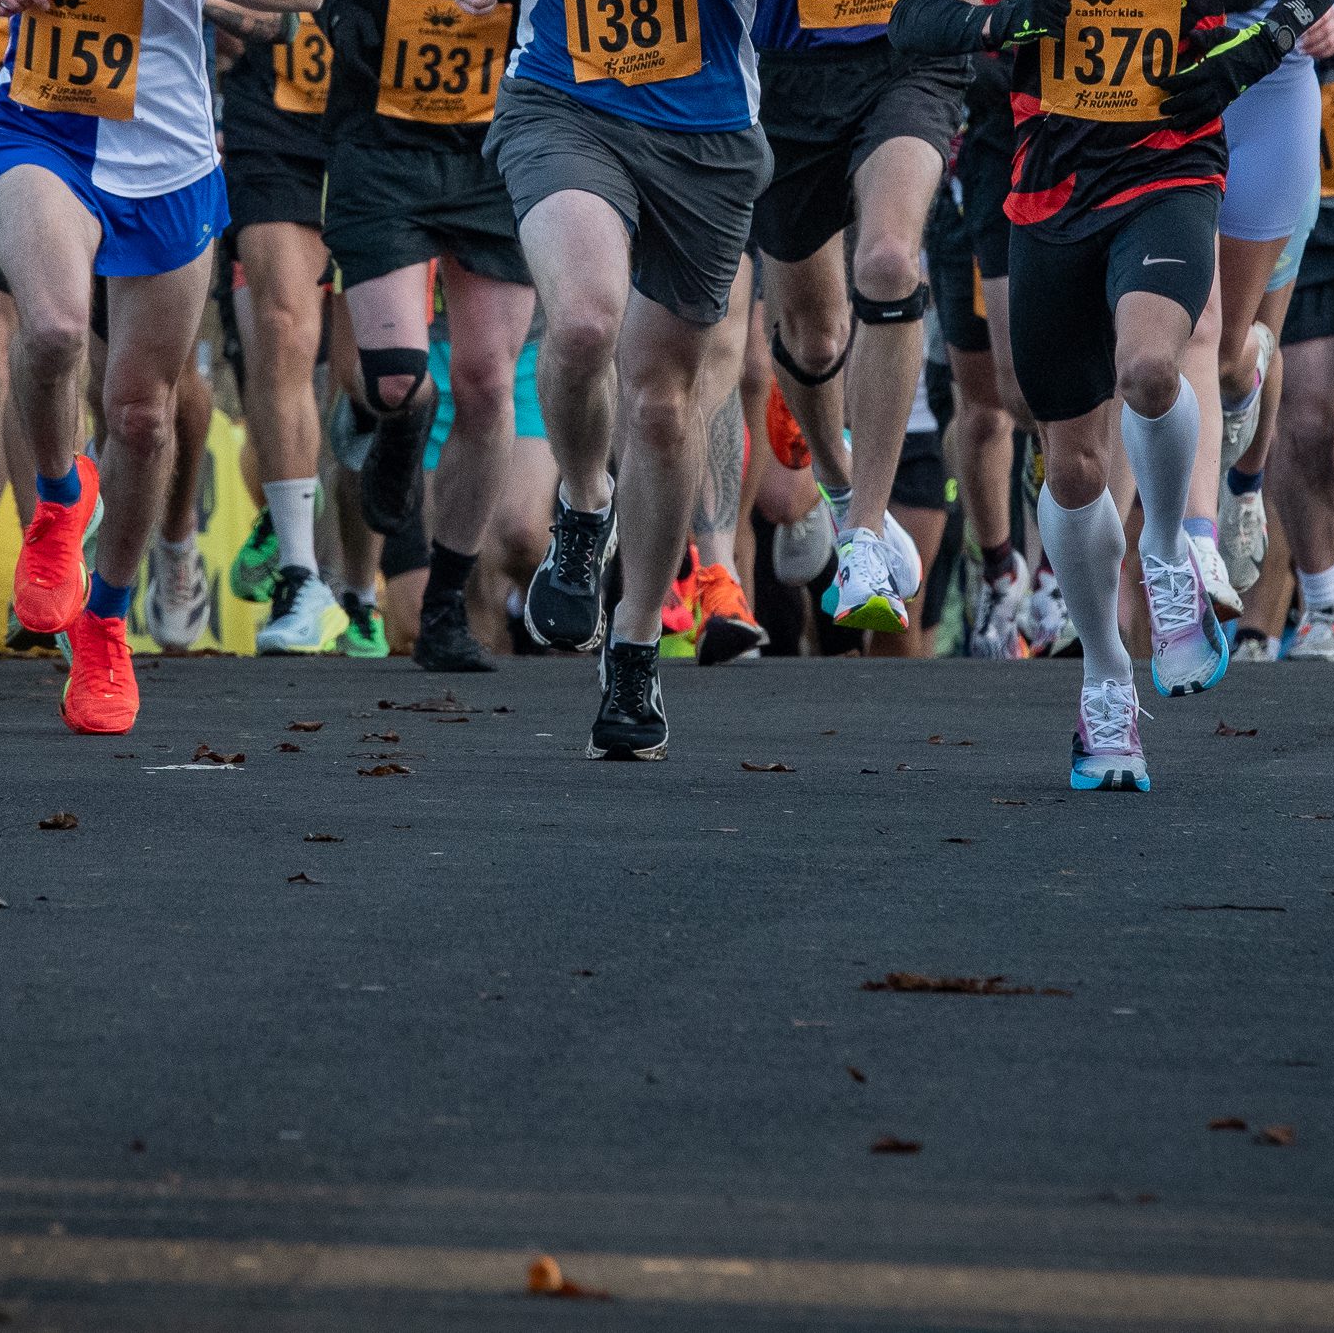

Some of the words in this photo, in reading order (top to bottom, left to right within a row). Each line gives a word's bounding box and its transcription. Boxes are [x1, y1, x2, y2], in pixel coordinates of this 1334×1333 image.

[1075, 8, 1144, 18] cashforkids
[24, 16, 134, 90] 1159
[622, 54, 637, 64] UP
[637, 50, 659, 61] AND
[1053, 26, 1173, 87] 1370
[393, 38, 494, 95] 1331
[619, 57, 665, 75] RUNNING
[1094, 90, 1109, 99] UP
[1109, 90, 1133, 99] AND
[1089, 98, 1138, 109] RUNNING
